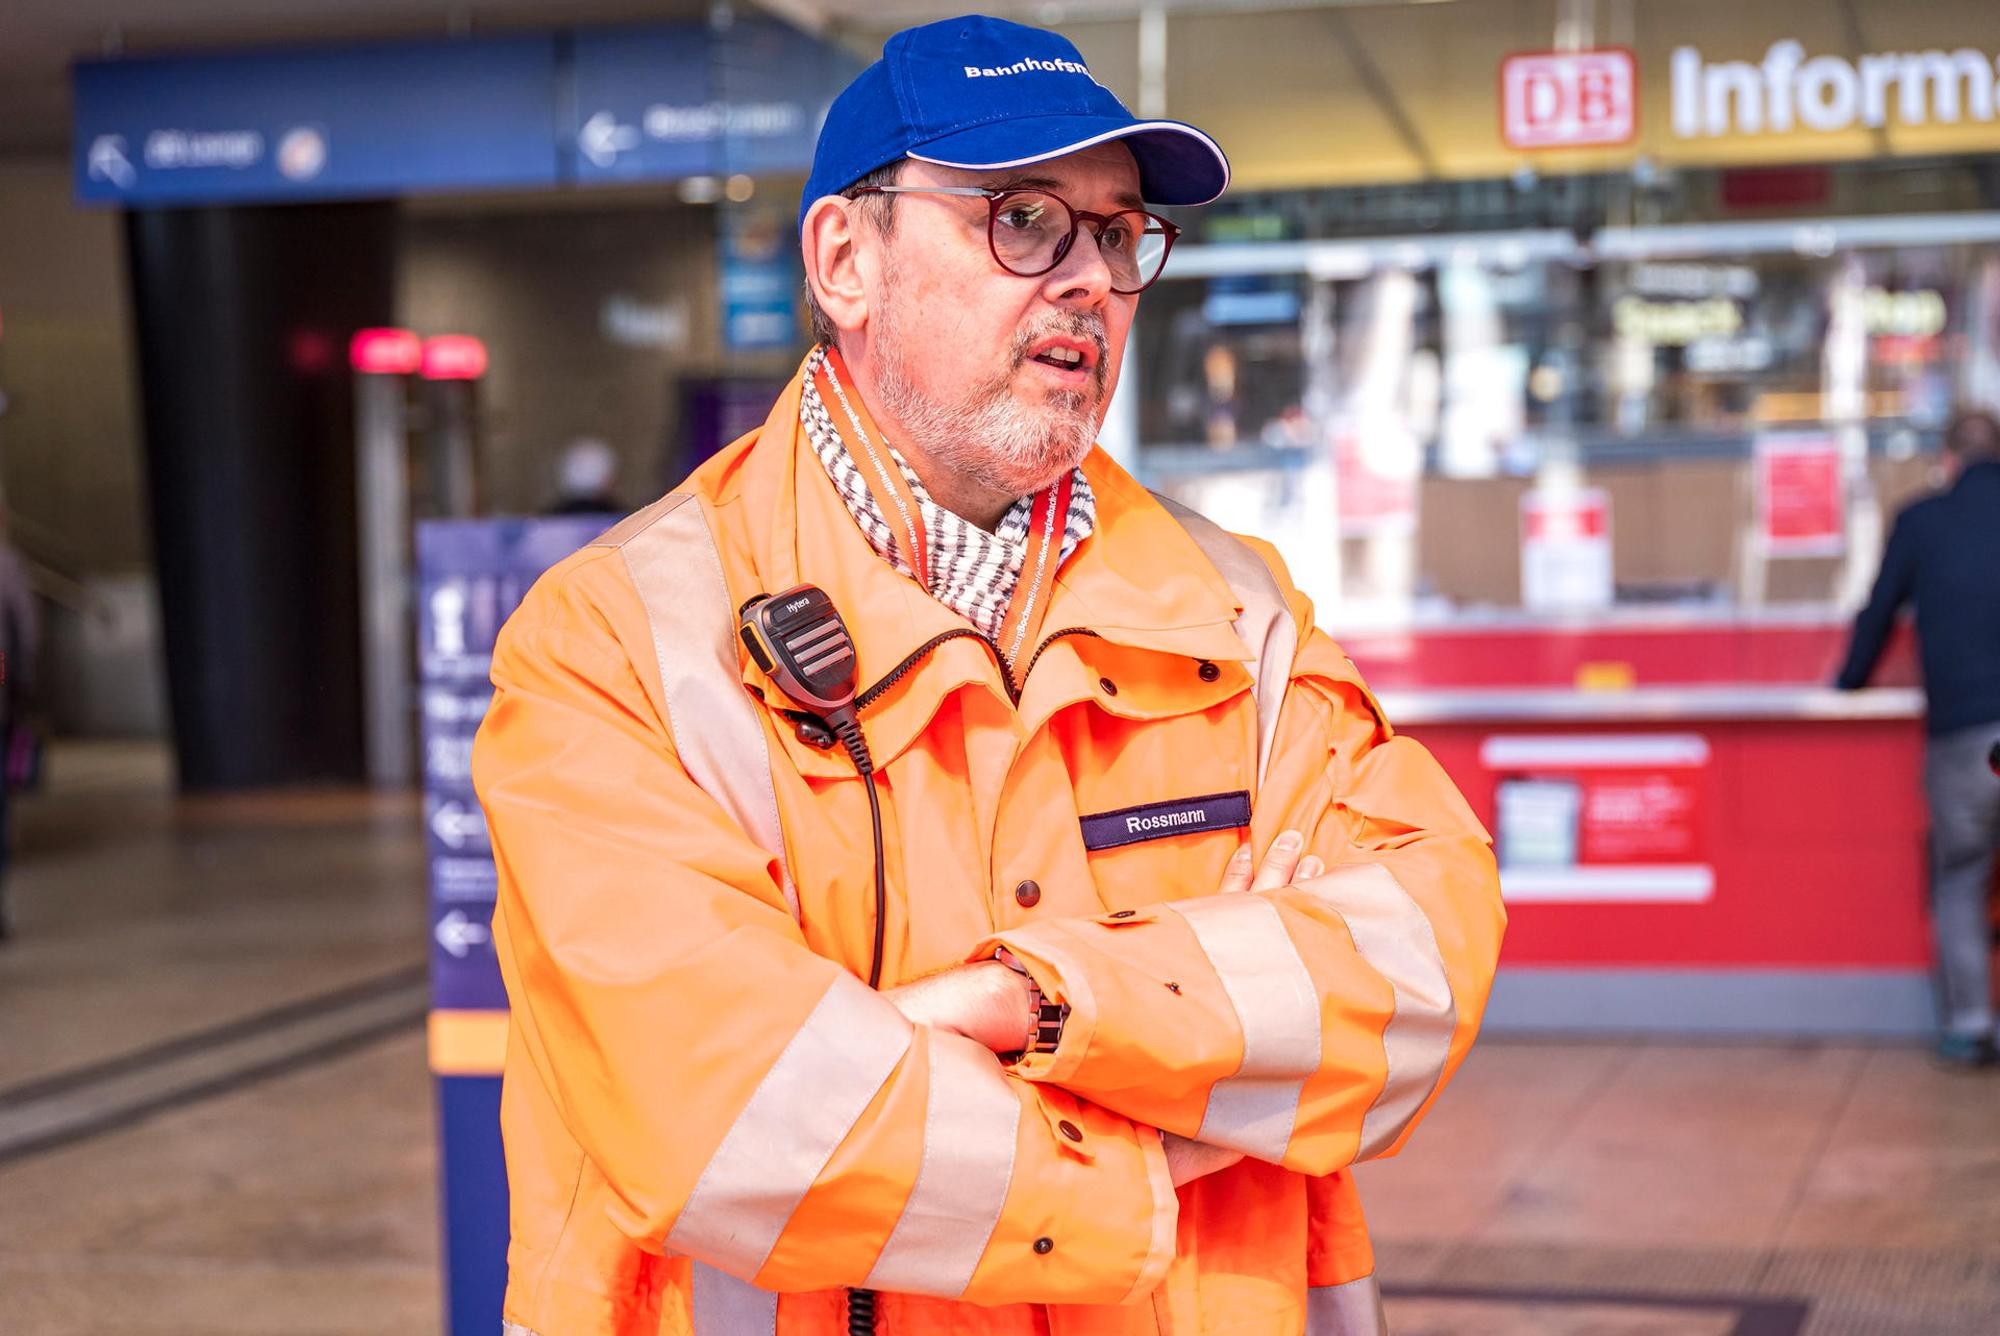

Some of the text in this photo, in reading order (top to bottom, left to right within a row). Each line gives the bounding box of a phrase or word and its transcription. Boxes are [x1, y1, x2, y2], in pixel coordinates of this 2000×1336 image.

[1523, 38, 2000, 138] DB Inform
[903, 517, 917, 544] Bonn
[785, 597, 810, 613] Hytera
[1126, 809, 1206, 834] Rossmann
